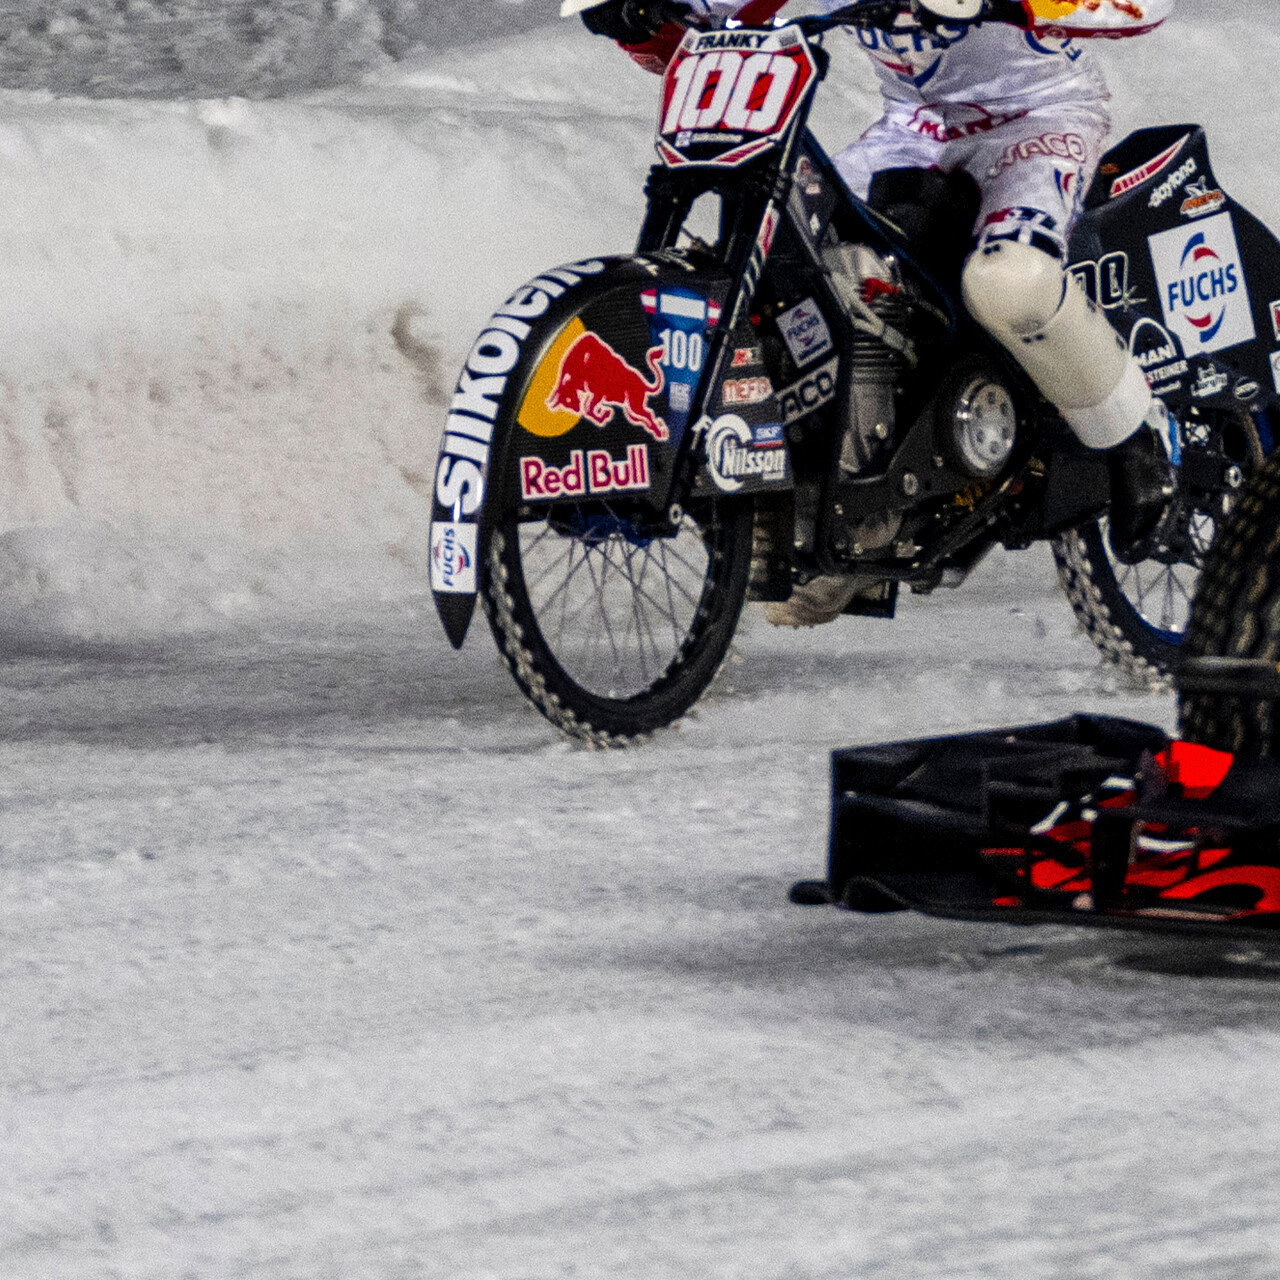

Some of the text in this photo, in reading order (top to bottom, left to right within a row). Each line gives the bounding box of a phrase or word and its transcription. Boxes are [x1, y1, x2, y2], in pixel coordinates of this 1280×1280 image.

[696, 24, 769, 50] FRANKY
[660, 51, 799, 135] 100
[918, 119, 993, 143] MAN
[1167, 263, 1238, 312] FUCHS
[658, 328, 703, 372] 100
[1133, 345, 1171, 365] MAN
[521, 445, 650, 499] Red Bull
[442, 527, 455, 587] FUCHS
